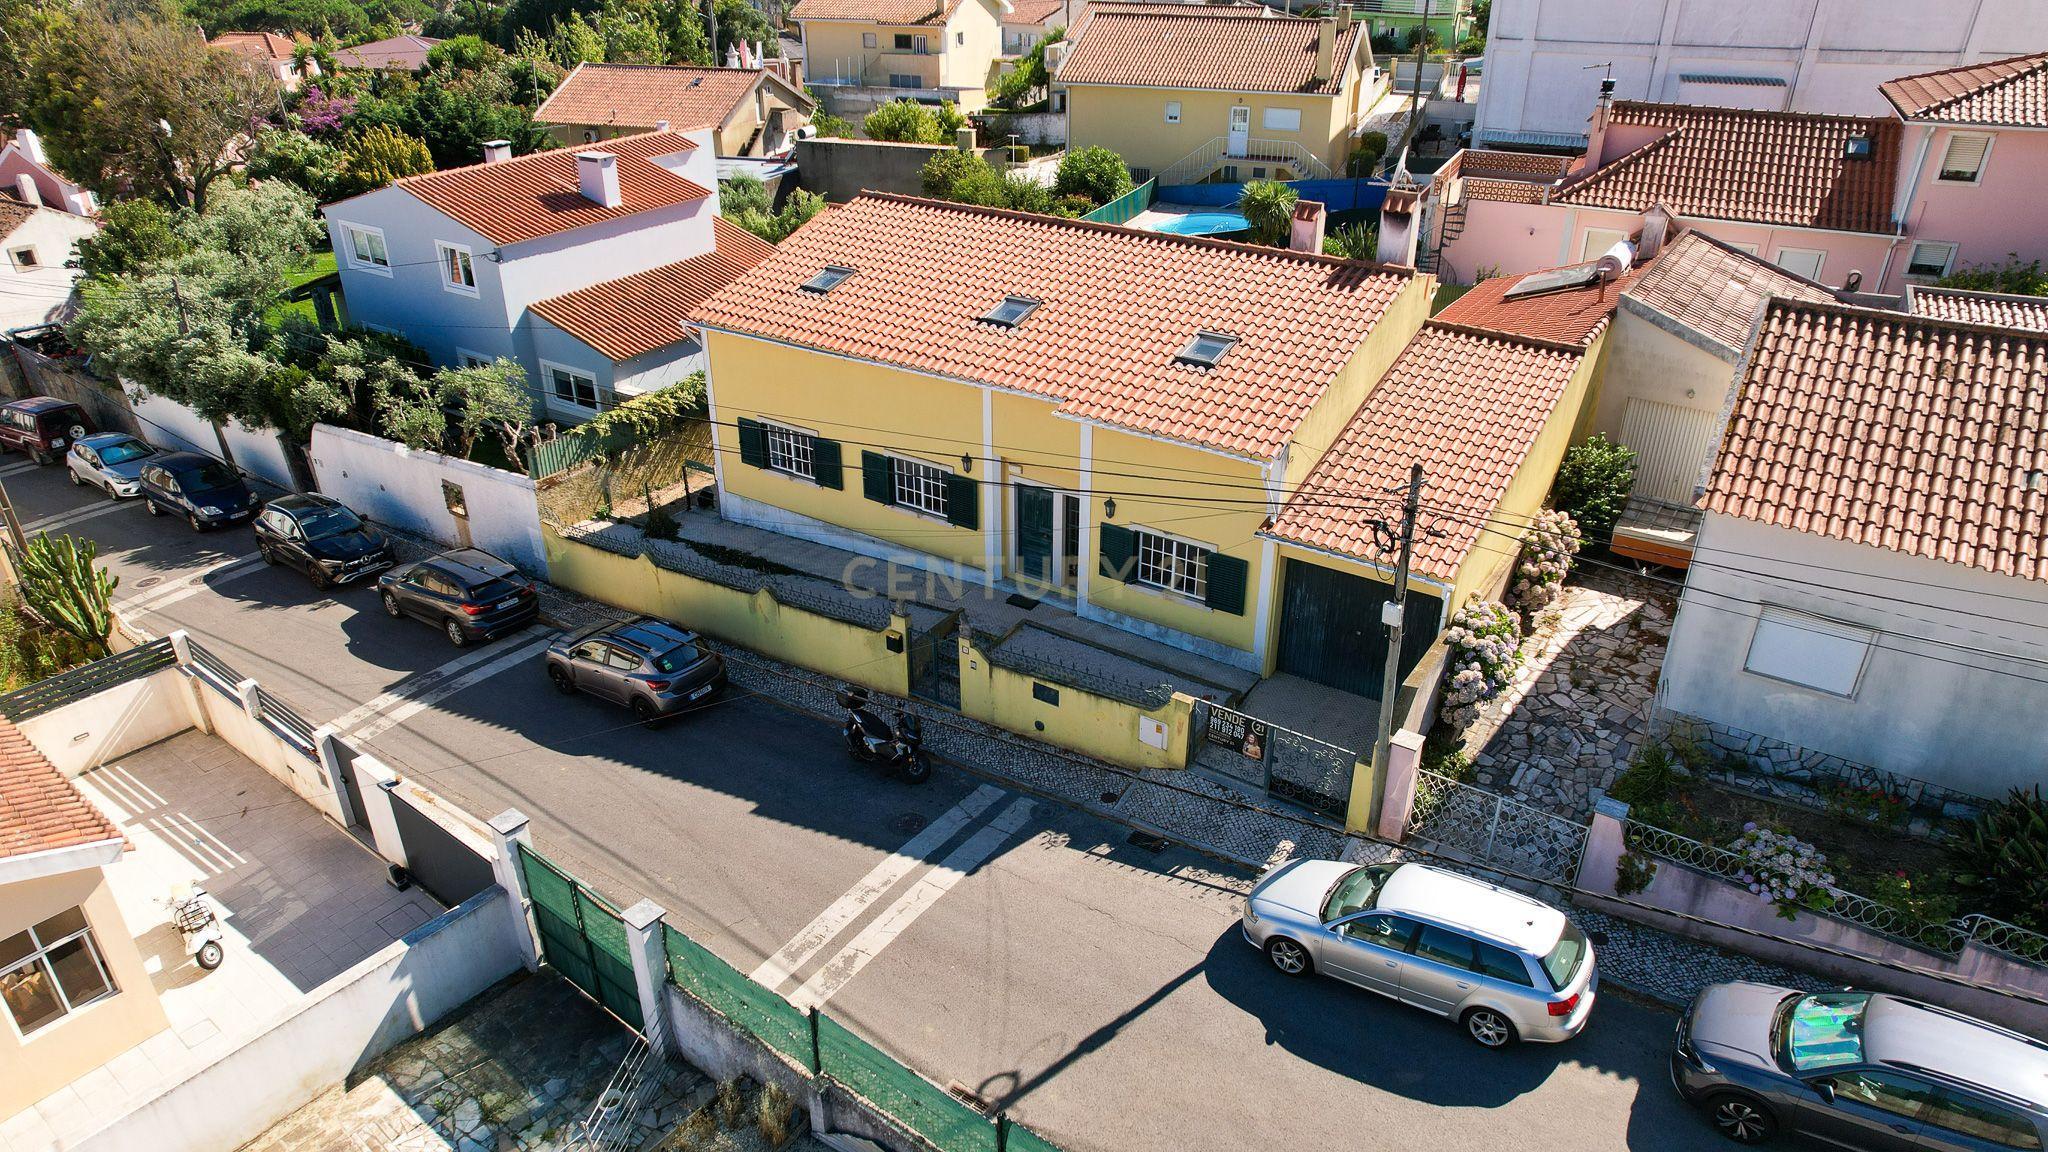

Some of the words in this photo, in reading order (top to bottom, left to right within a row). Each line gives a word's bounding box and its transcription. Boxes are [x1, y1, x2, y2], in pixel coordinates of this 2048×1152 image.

[1211, 706, 1246, 727] VENDE
[1209, 722, 1220, 731] 211
[1255, 723, 1265, 733] 21
